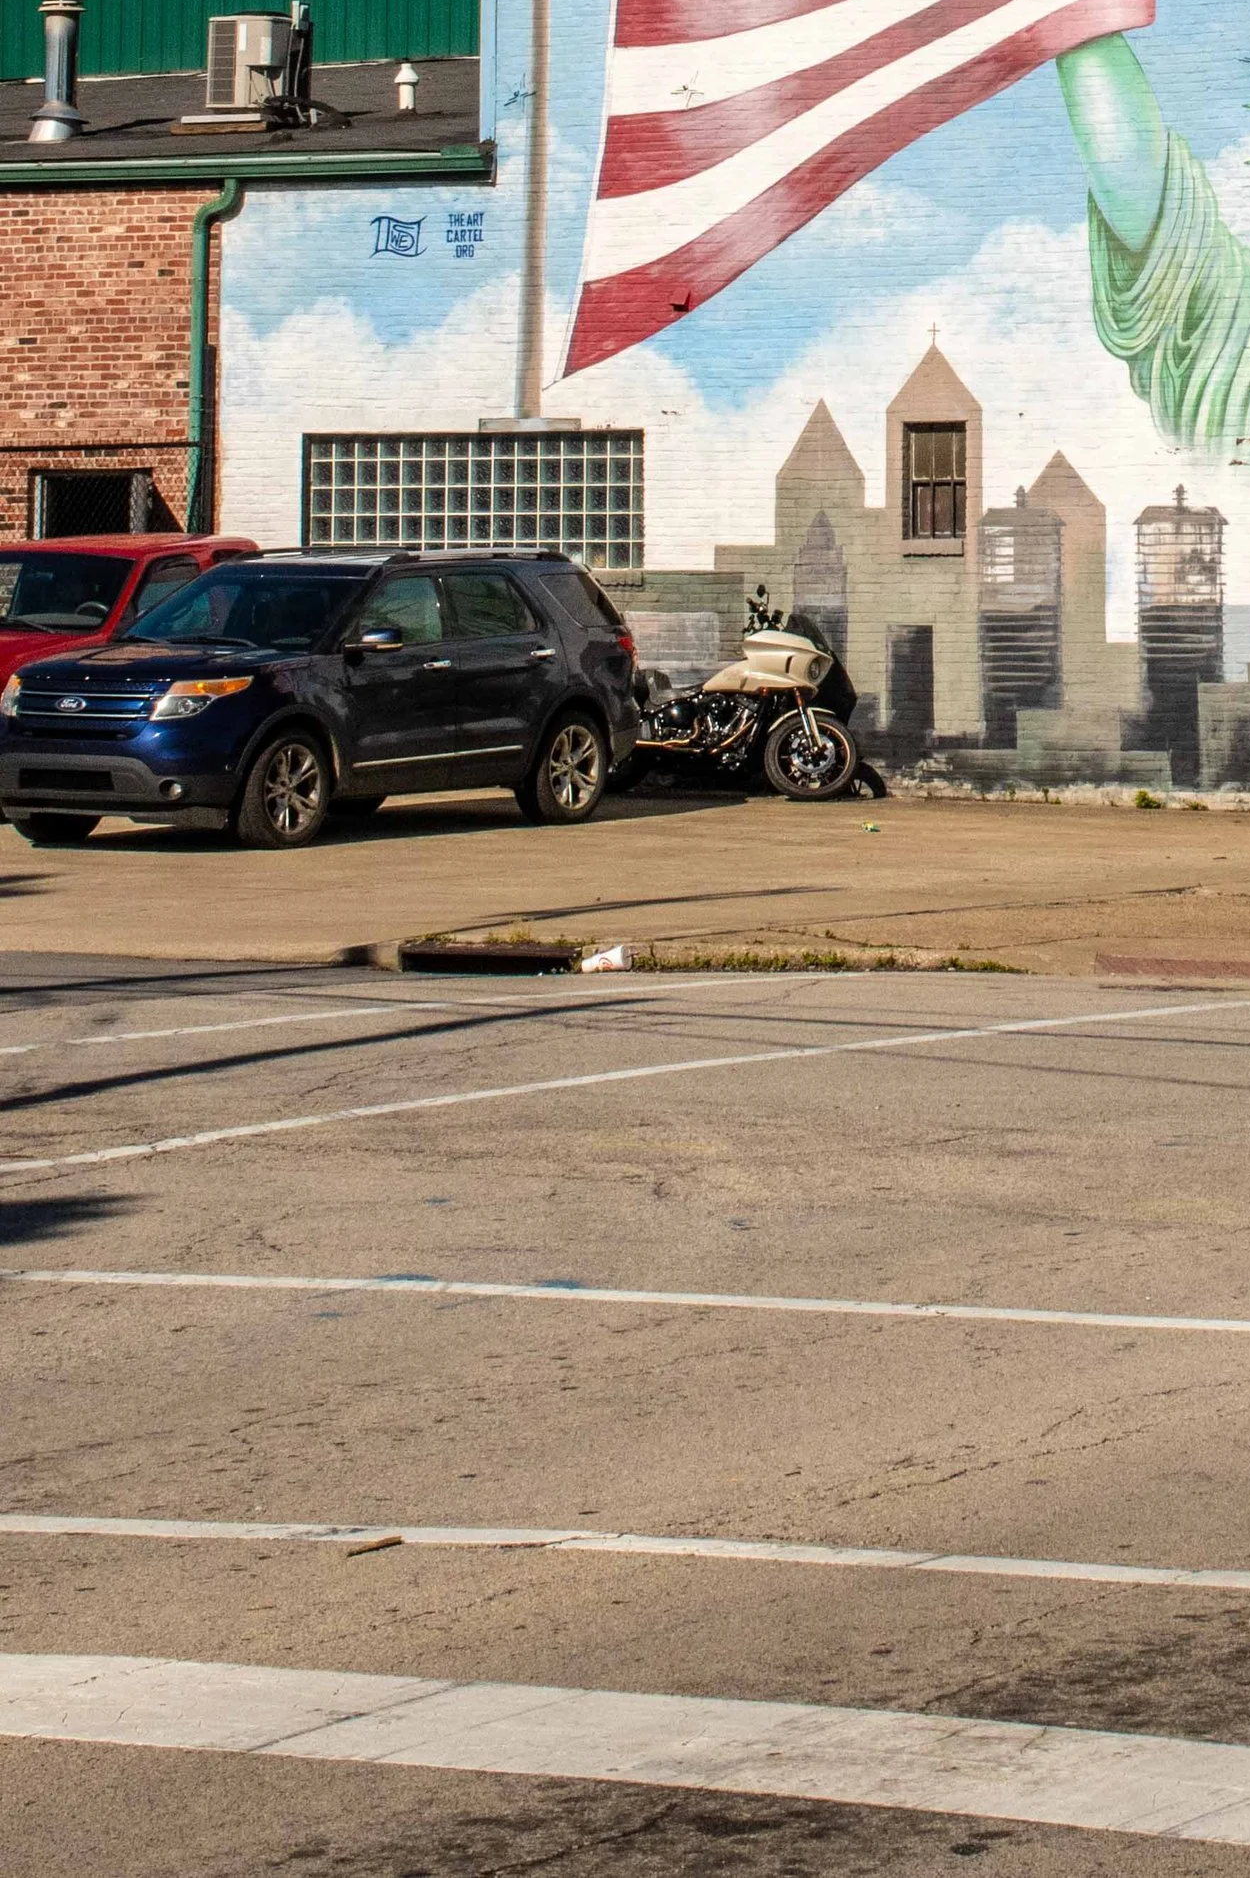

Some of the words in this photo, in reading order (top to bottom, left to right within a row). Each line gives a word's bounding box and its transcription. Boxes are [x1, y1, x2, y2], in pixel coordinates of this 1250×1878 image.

[448, 213, 466, 227] THE
[467, 212, 484, 227] ART
[446, 229, 484, 243] CARTEL
[452, 244, 475, 258] .ORG
